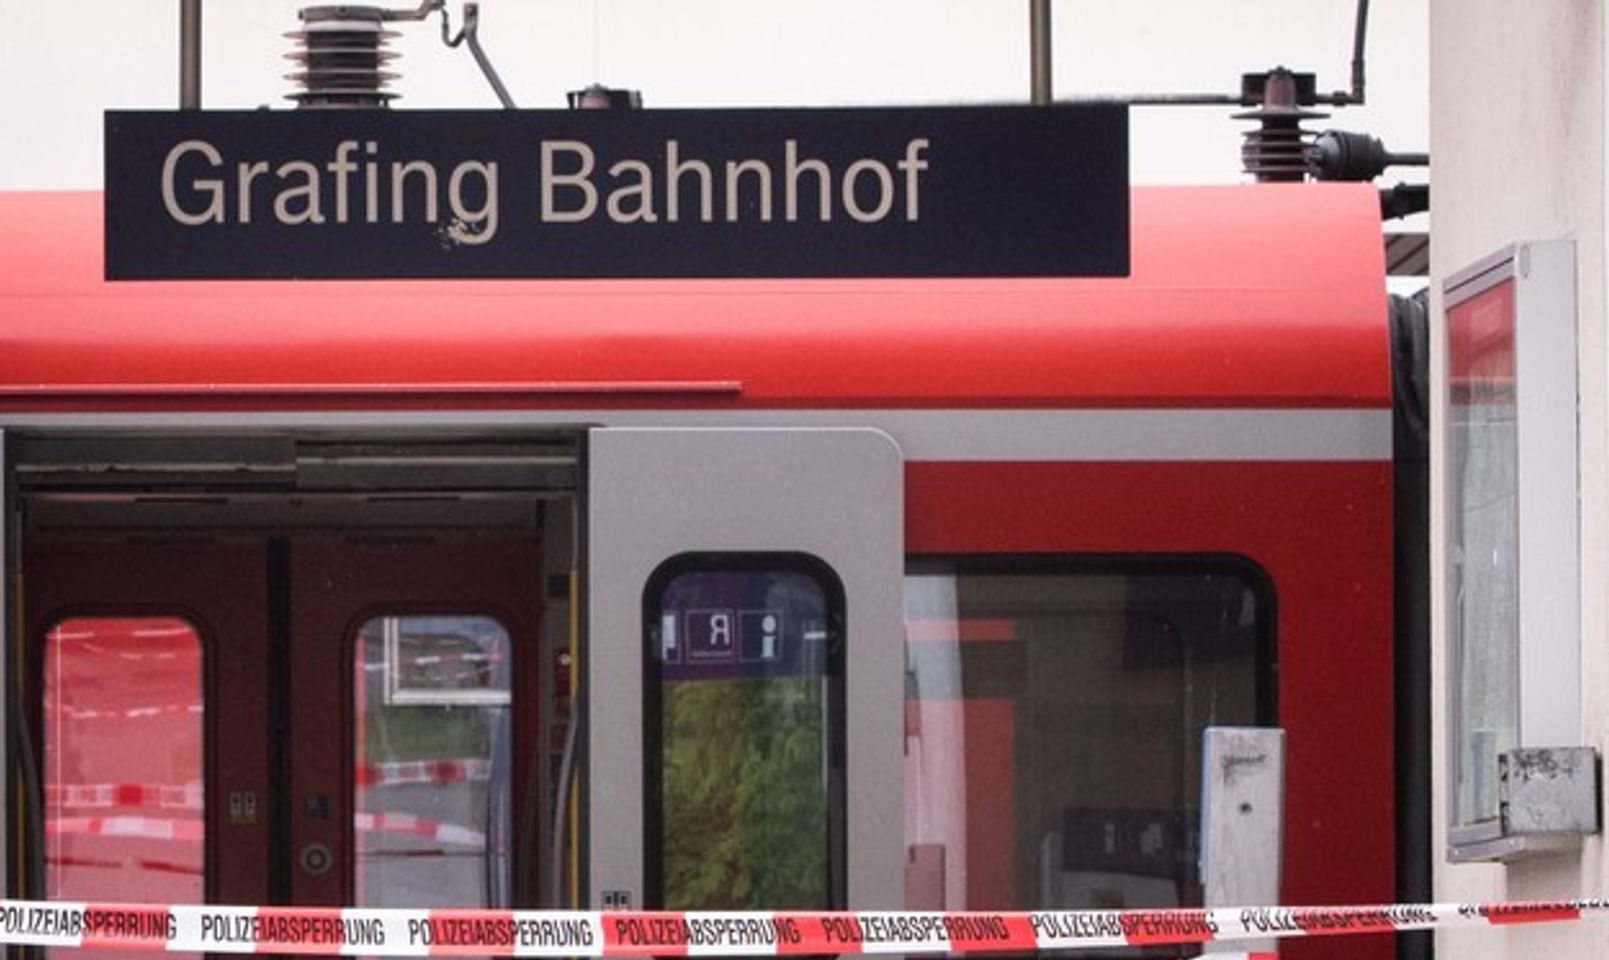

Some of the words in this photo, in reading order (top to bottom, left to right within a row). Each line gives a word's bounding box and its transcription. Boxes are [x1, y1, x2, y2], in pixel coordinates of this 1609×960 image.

[161, 140, 499, 245] Grafing
[539, 138, 929, 223] Bahnhof
[201, 914, 385, 946] POLIZEIABSPERRUNG
[408, 918, 593, 946] POLIZEIABSPERRUNG
[615, 918, 801, 946] POLIZEIABSPERRUNG
[821, 915, 1010, 943] POLIZEIABSPERRUNG
[1028, 911, 1219, 938] POLIZEIABSPERRUNG
